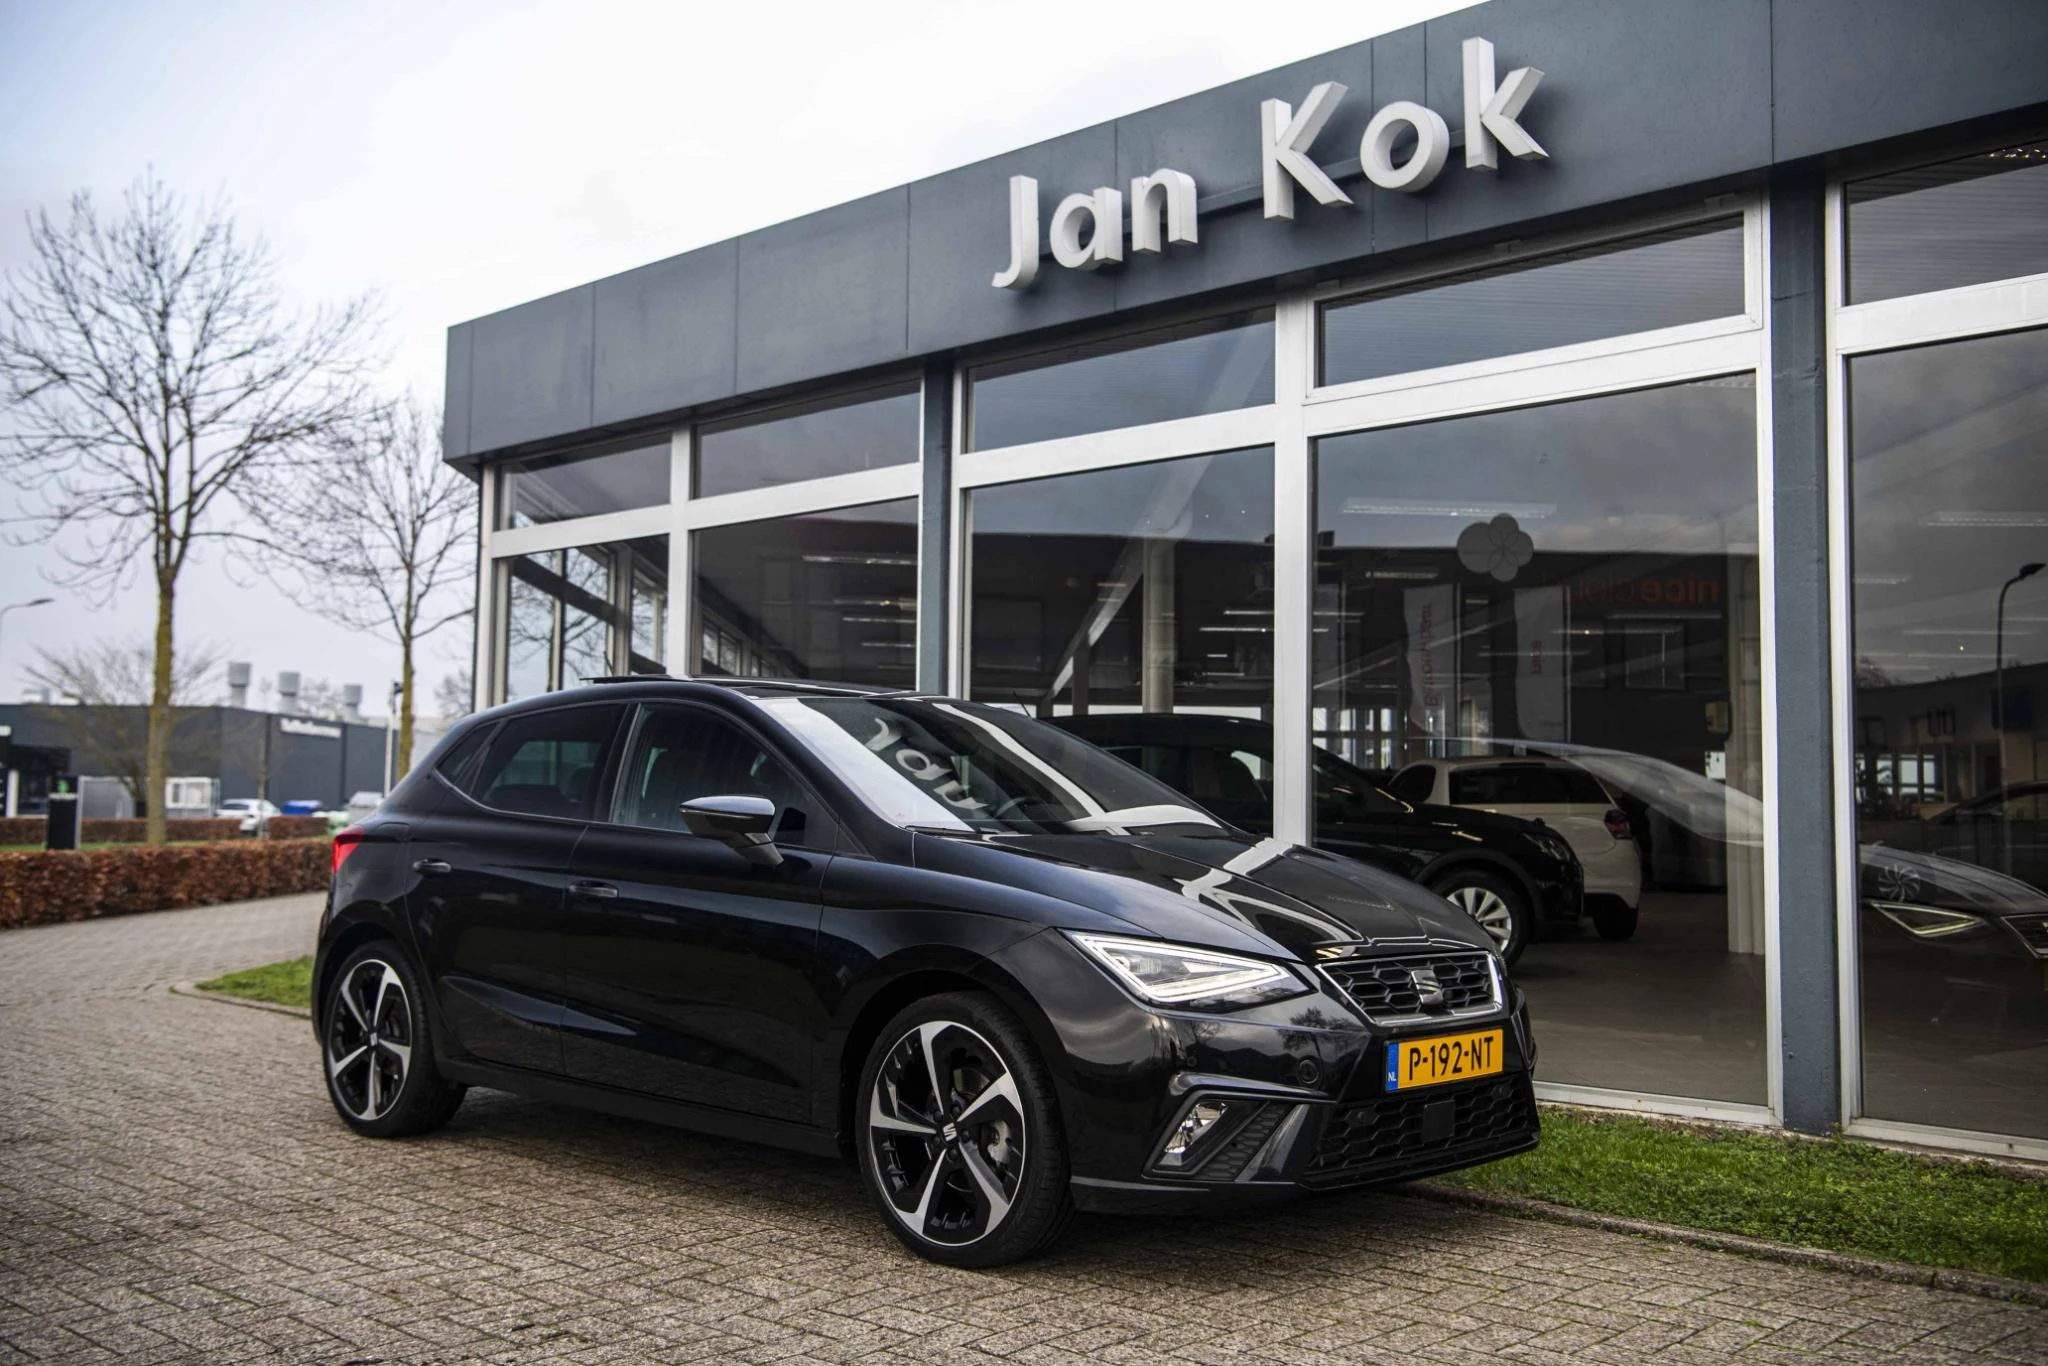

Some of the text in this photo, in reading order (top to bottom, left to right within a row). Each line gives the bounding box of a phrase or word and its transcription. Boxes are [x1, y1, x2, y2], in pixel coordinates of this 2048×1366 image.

[992, 37, 1549, 290] Jan Kok
[1388, 1071, 1397, 1083] NL
[1410, 1037, 1493, 1080] P-192-NT
